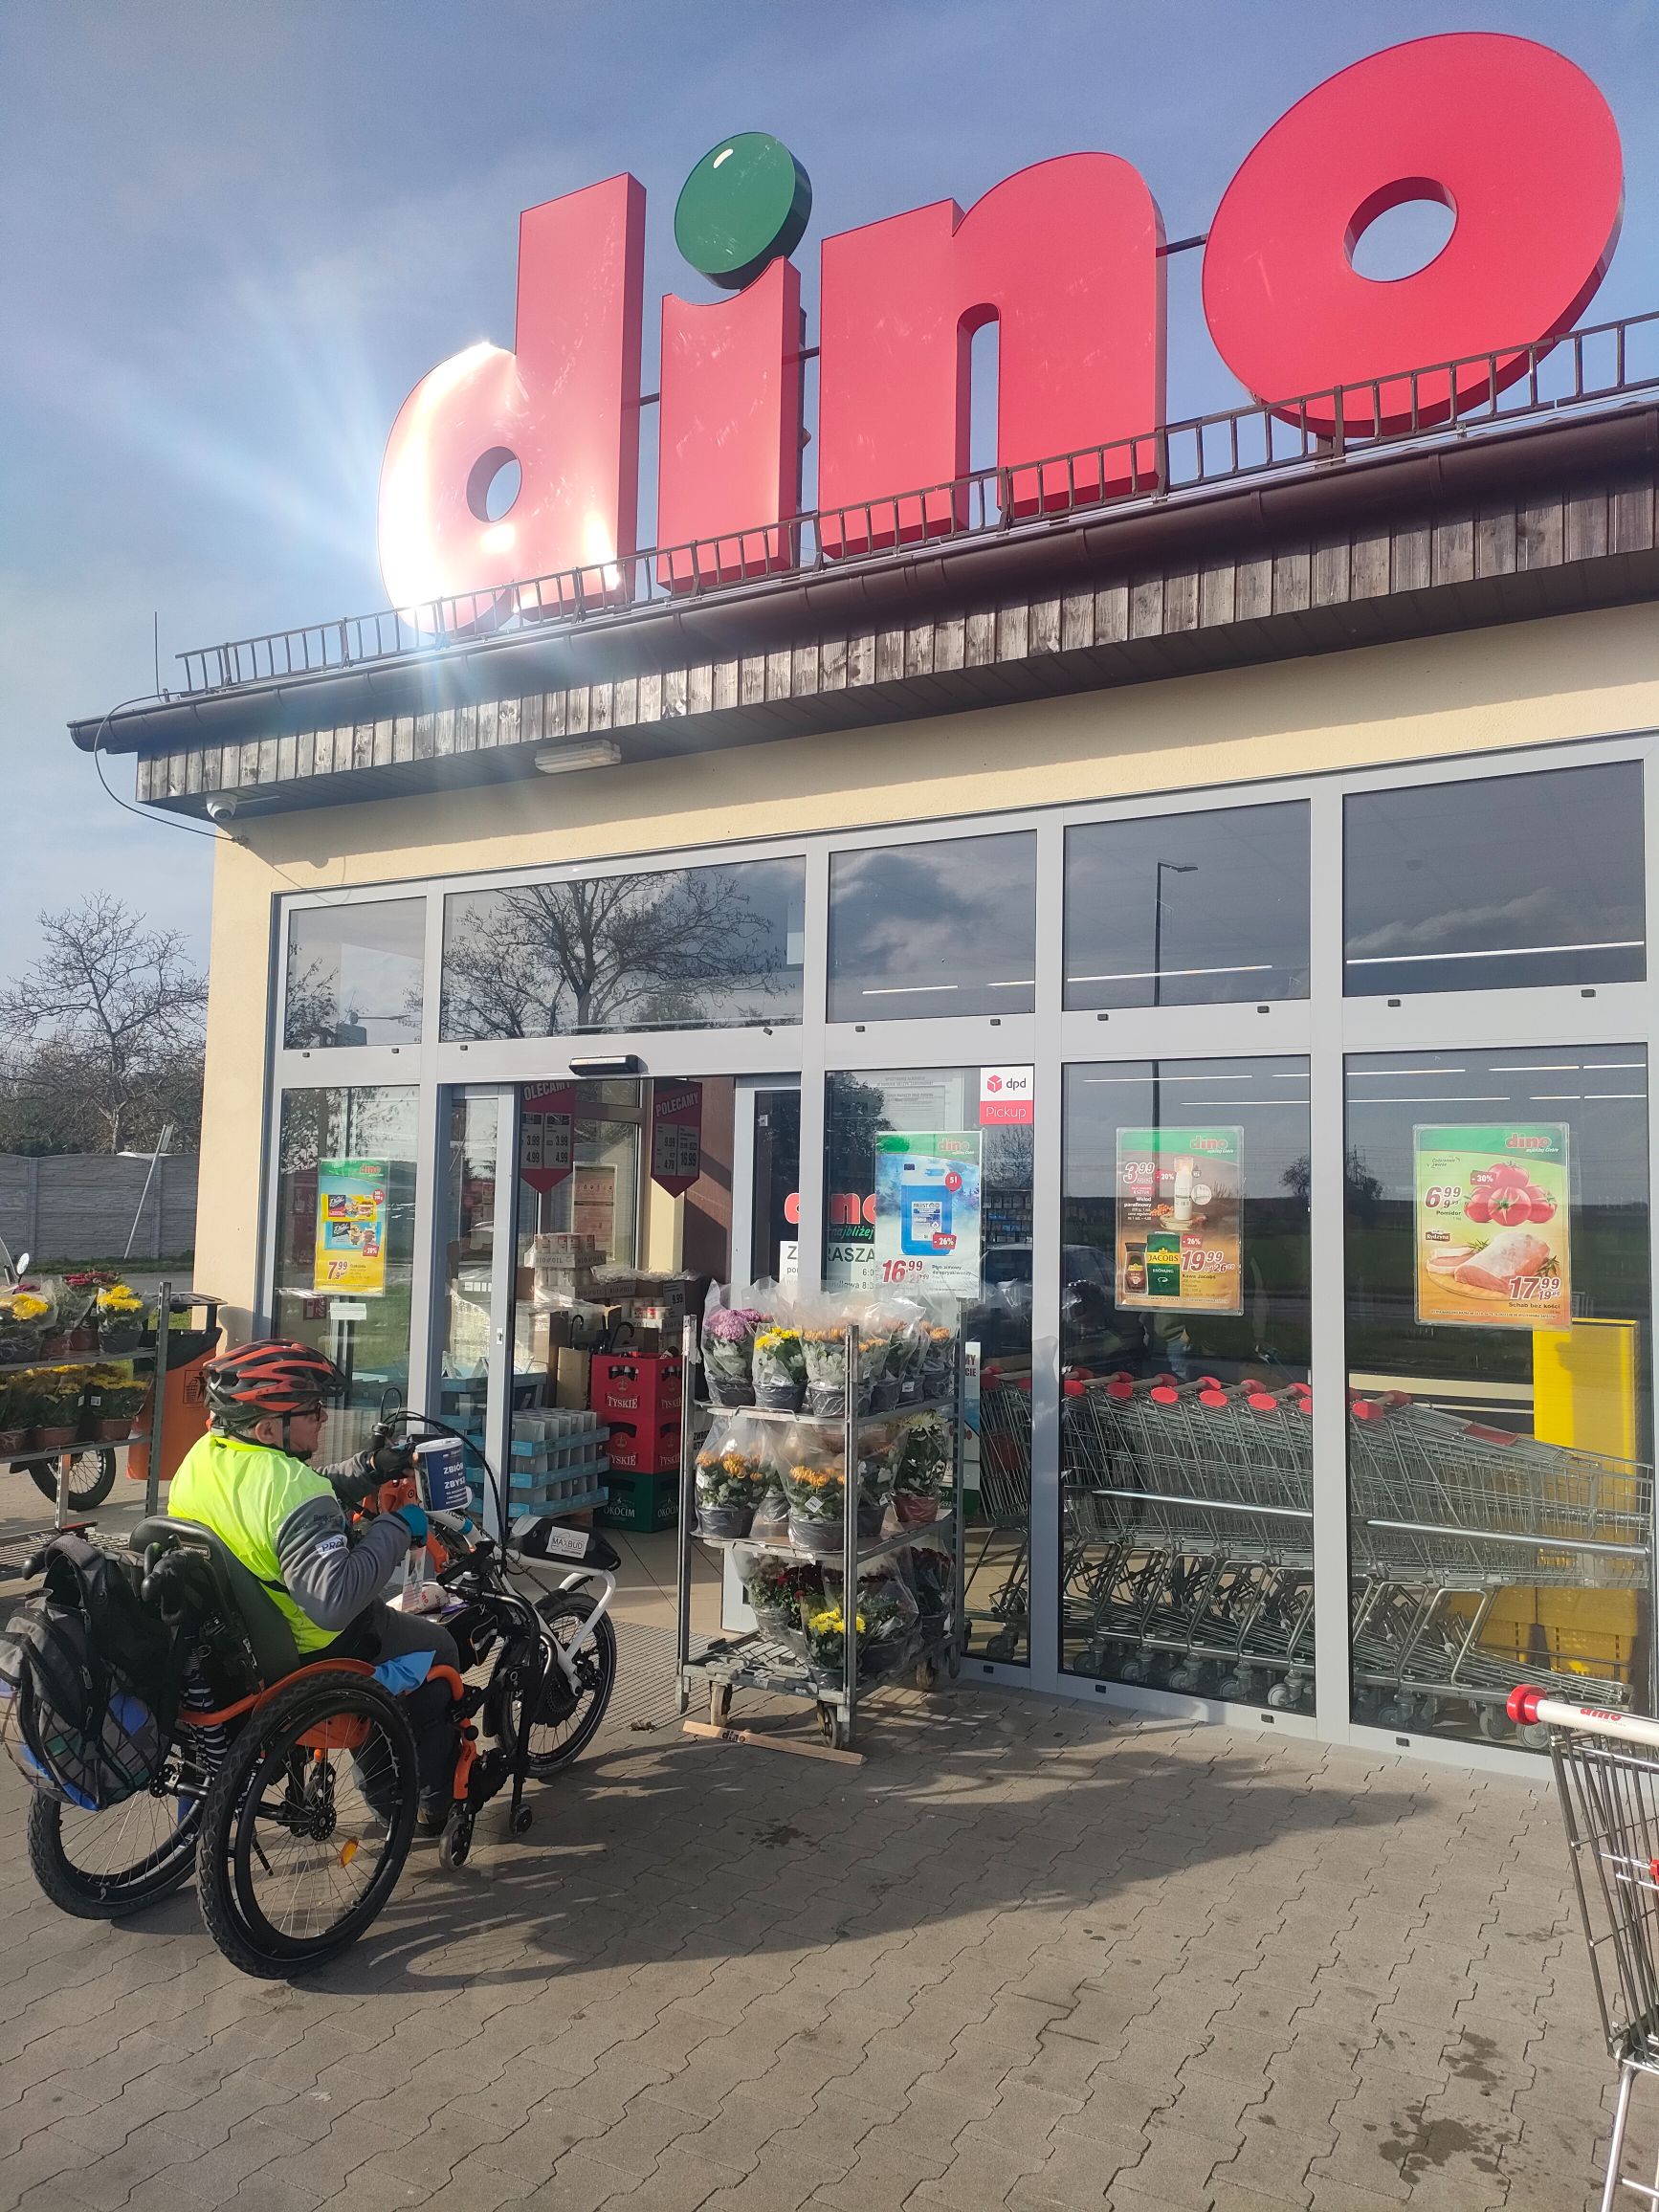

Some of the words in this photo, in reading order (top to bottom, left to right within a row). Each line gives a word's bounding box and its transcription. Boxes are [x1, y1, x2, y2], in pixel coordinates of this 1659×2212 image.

[379, 32, 1624, 634] dino
[523, 1082, 571, 1100] OLECAM
[1006, 1078, 1027, 1091] dpd
[655, 1092, 698, 1117] POLECAMY
[986, 1106, 1027, 1119] Pickup
[1190, 1136, 1228, 1149] dino
[1506, 1133, 1552, 1149] dino
[939, 1237, 954, 1246] 26%
[1149, 1253, 1179, 1262] JACOBS
[672, 1294, 683, 1304] 9.99
[608, 1395, 638, 1409] TYSKIE
[604, 1507, 635, 1518] OKOCIM
[552, 1537, 583, 1550] MAXBUD
[1580, 1707, 1623, 1722] dino
[721, 1730, 746, 1743] dino
